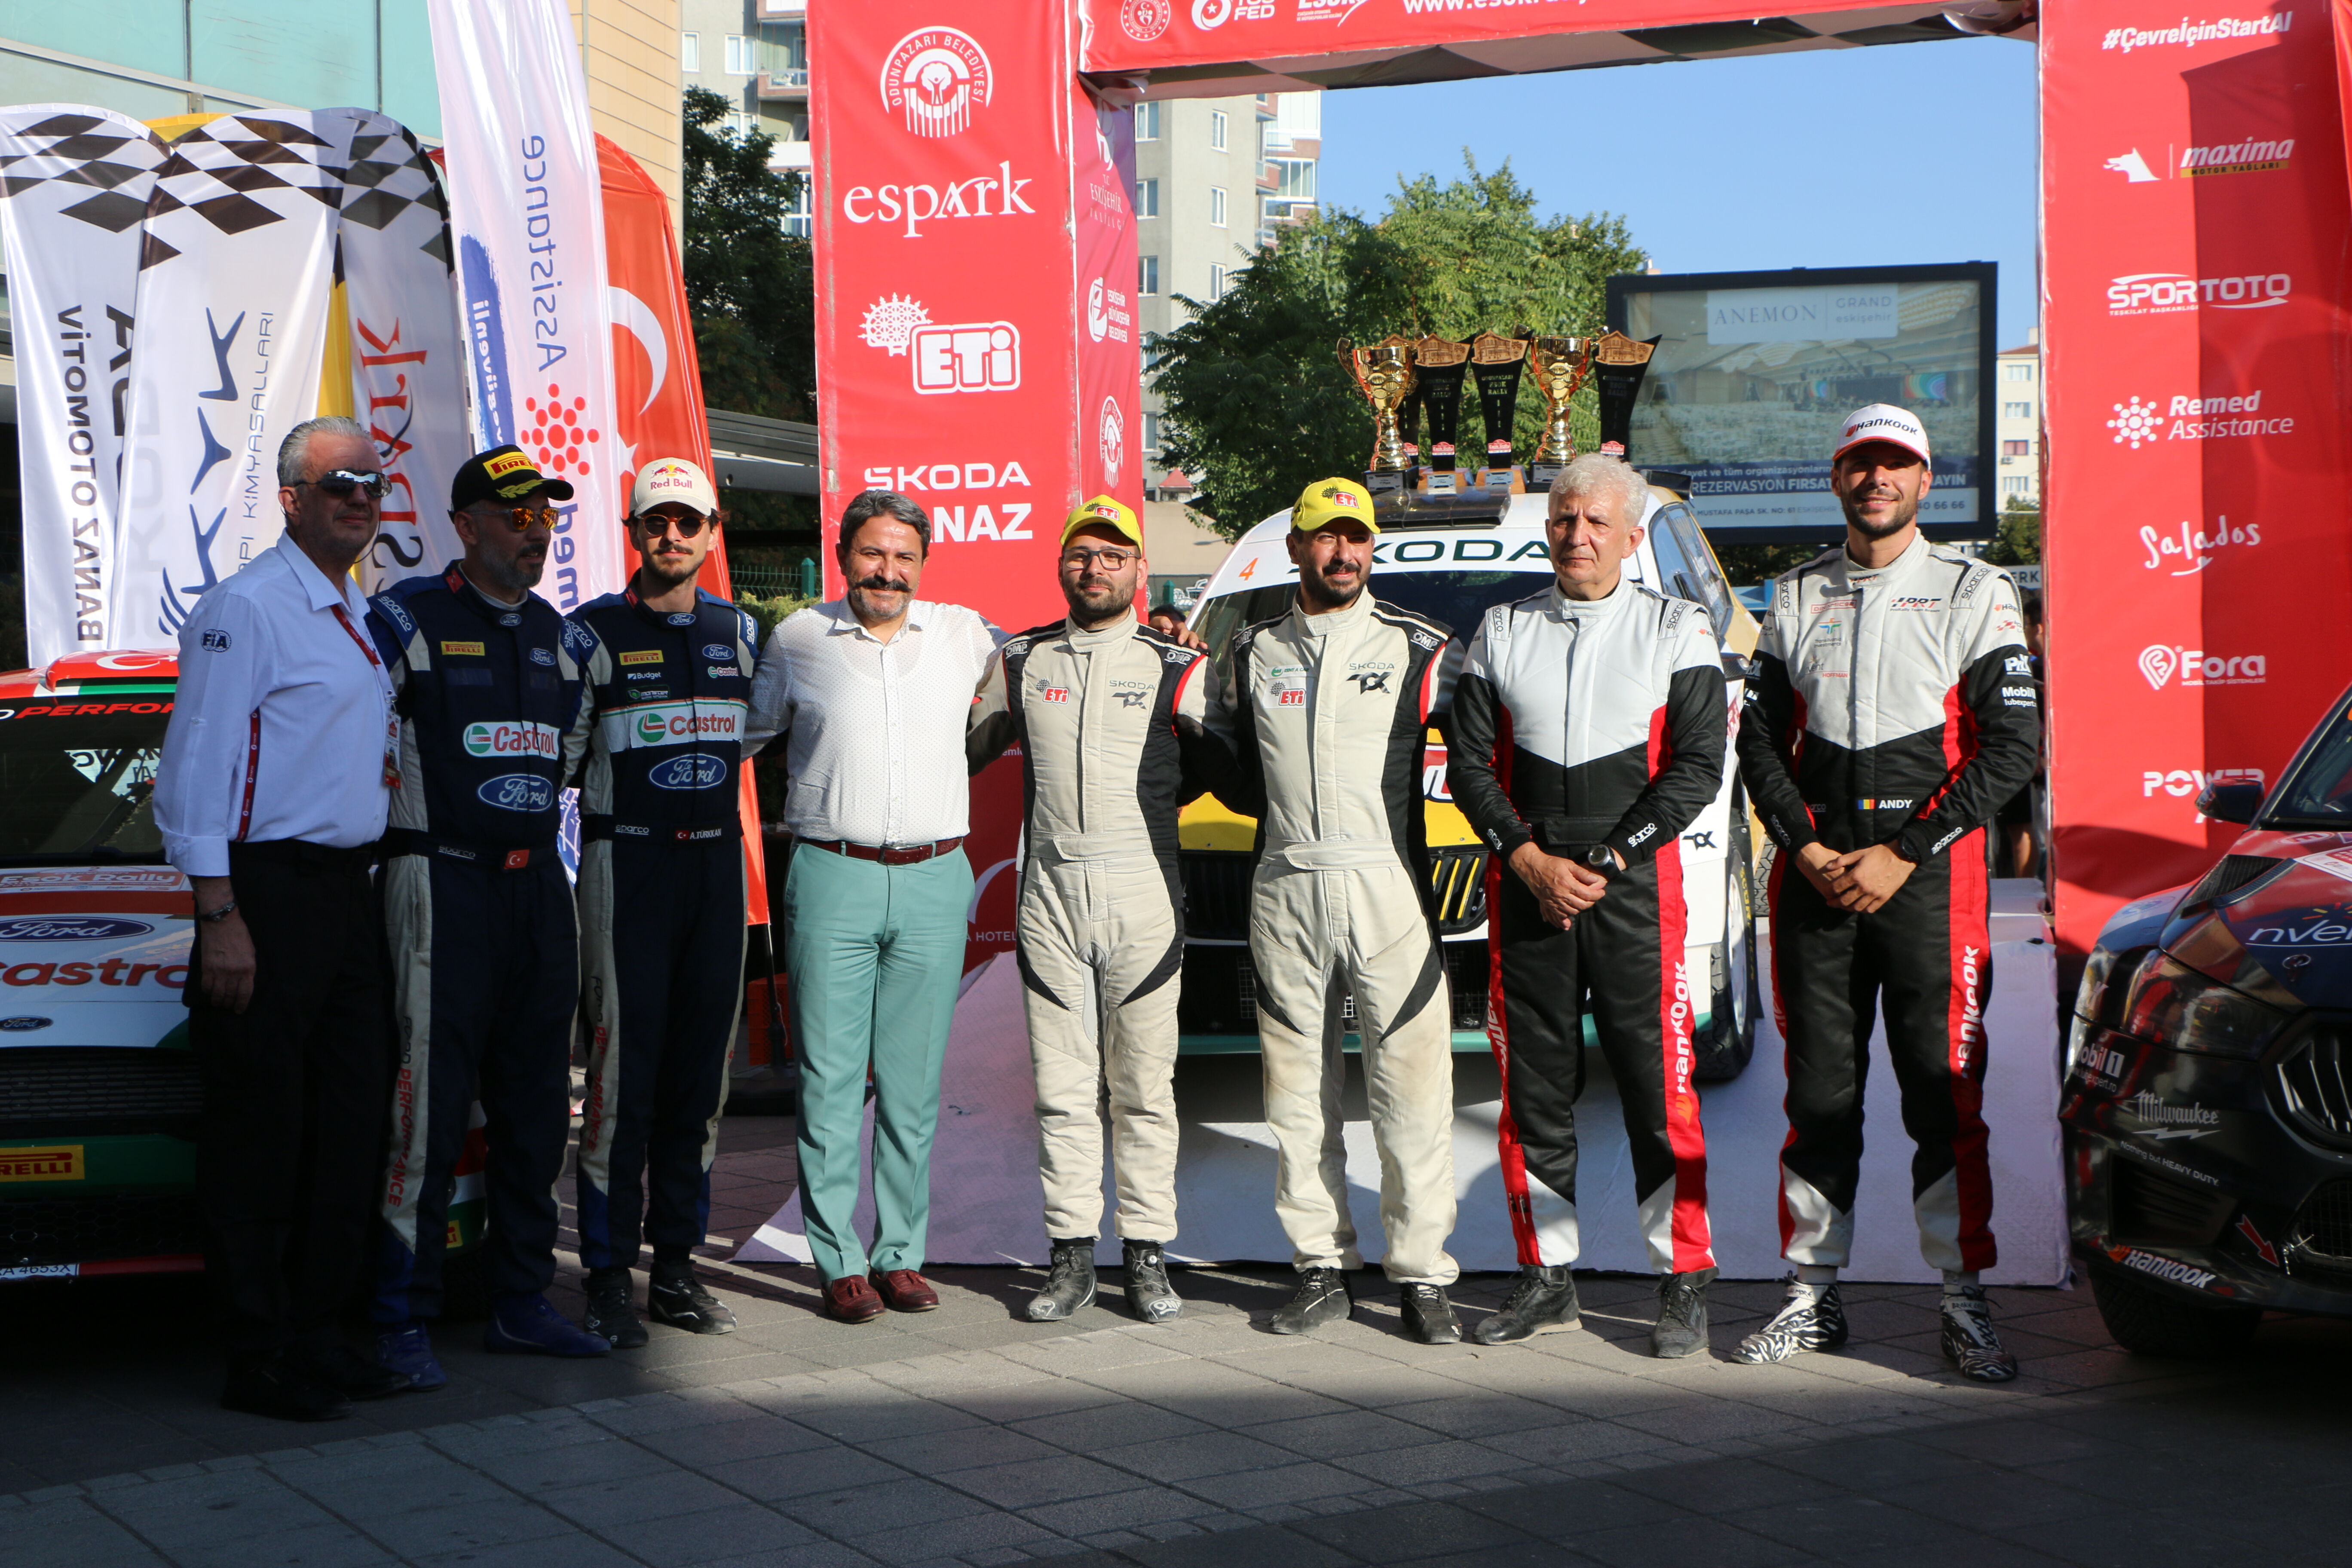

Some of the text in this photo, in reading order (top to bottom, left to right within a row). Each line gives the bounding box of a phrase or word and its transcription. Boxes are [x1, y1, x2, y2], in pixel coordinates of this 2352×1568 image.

[889, 34, 986, 107] ODUNPAZARI BELEDİYESİ
[2180, 137, 2295, 168] maxima
[843, 160, 1036, 238] espark
[1090, 183, 1123, 214] ESKİŞEHİR
[1835, 296, 1891, 309] GRAND
[1713, 303, 1819, 326] ANEMON
[1836, 312, 1891, 325] eskişehir
[2169, 390, 2261, 416] Remed
[242, 310, 274, 519] KİMYASALLARI
[2168, 416, 2294, 440] Assistance
[1681, 469, 1708, 478] davet
[1723, 468, 1743, 476] tüm
[650, 478, 692, 491] Red Bull
[1693, 479, 1785, 493] REZERVASYON
[1788, 478, 1832, 490] FIRSAT
[1951, 501, 1965, 509] 66
[1238, 557, 1259, 581] 4
[1960, 567, 1989, 600] sparco
[380, 596, 412, 632] sparco
[1666, 601, 1687, 631] sparco
[445, 643, 481, 653] PIRELLI
[1005, 643, 1028, 655] OMP
[1413, 632, 1438, 649] OMP
[532, 650, 552, 664] Ford
[624, 652, 659, 663] PIRELLI
[709, 646, 730, 658] Ford
[1167, 651, 1191, 664] OMP
[717, 667, 739, 677] Castrol
[2181, 650, 2266, 678] Fora
[637, 671, 662, 680] Budget
[669, 714, 735, 735] Castrol
[493, 726, 557, 755] Castrol
[668, 759, 717, 785] Ford
[498, 778, 548, 804] Ford
[1878, 799, 1913, 809] ANDY
[615, 824, 650, 835] sparco
[438, 845, 476, 859] sparco
[0, 873, 175, 883] Esok Rally
[1, 920, 116, 937] Ford
[3, 1017, 37, 1028] Ford
[2133, 1089, 2220, 1124] Milwaukee
[2120, 1140, 2147, 1160] Nothing
[2149, 1152, 2161, 1164] but
[2162, 1158, 2191, 1175] HEAVY
